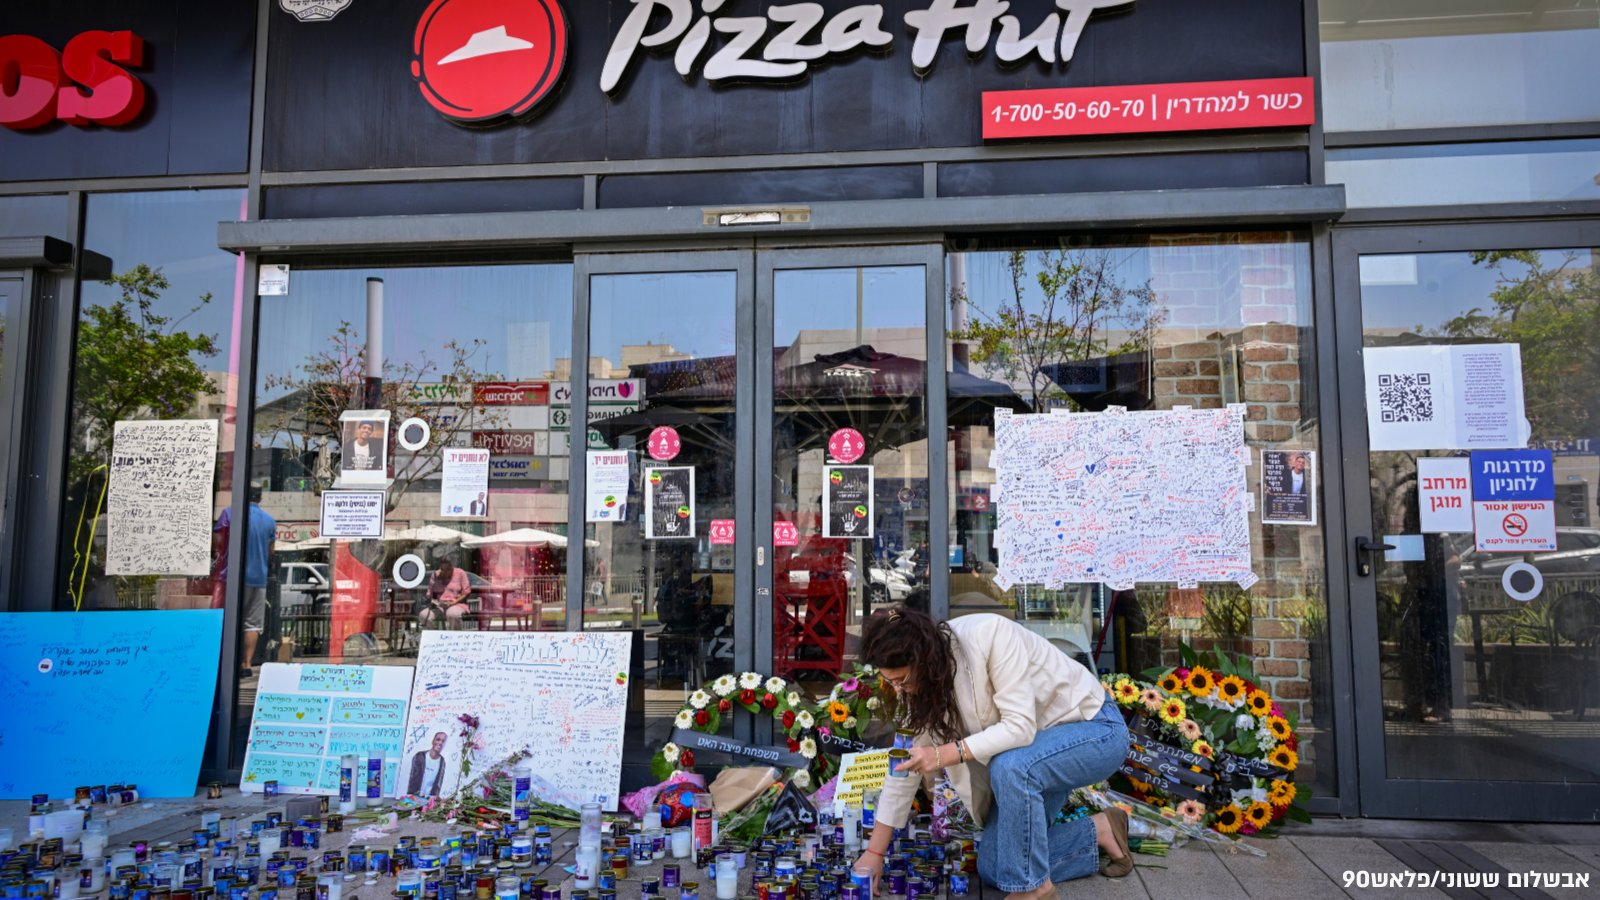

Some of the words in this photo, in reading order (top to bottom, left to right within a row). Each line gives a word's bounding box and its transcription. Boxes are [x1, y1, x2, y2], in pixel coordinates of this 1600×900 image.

[600, 0, 893, 94] Pizza
[903, 0, 1136, 70] Hut
[1166, 95, 1250, 122] למהדרין
[1256, 92, 1303, 112] כשר
[991, 98, 1145, 124] 1-700-50-60-70
[1483, 459, 1545, 474] מדרגות
[1423, 477, 1467, 490] מרחב
[1490, 476, 1538, 495] לחניון
[1430, 496, 1461, 512] מוגן
[1483, 503, 1509, 511] אסור
[1511, 503, 1545, 511] העישון
[697, 737, 718, 749] האט
[719, 742, 741, 754] פיצה
[742, 746, 780, 761] משפחת
